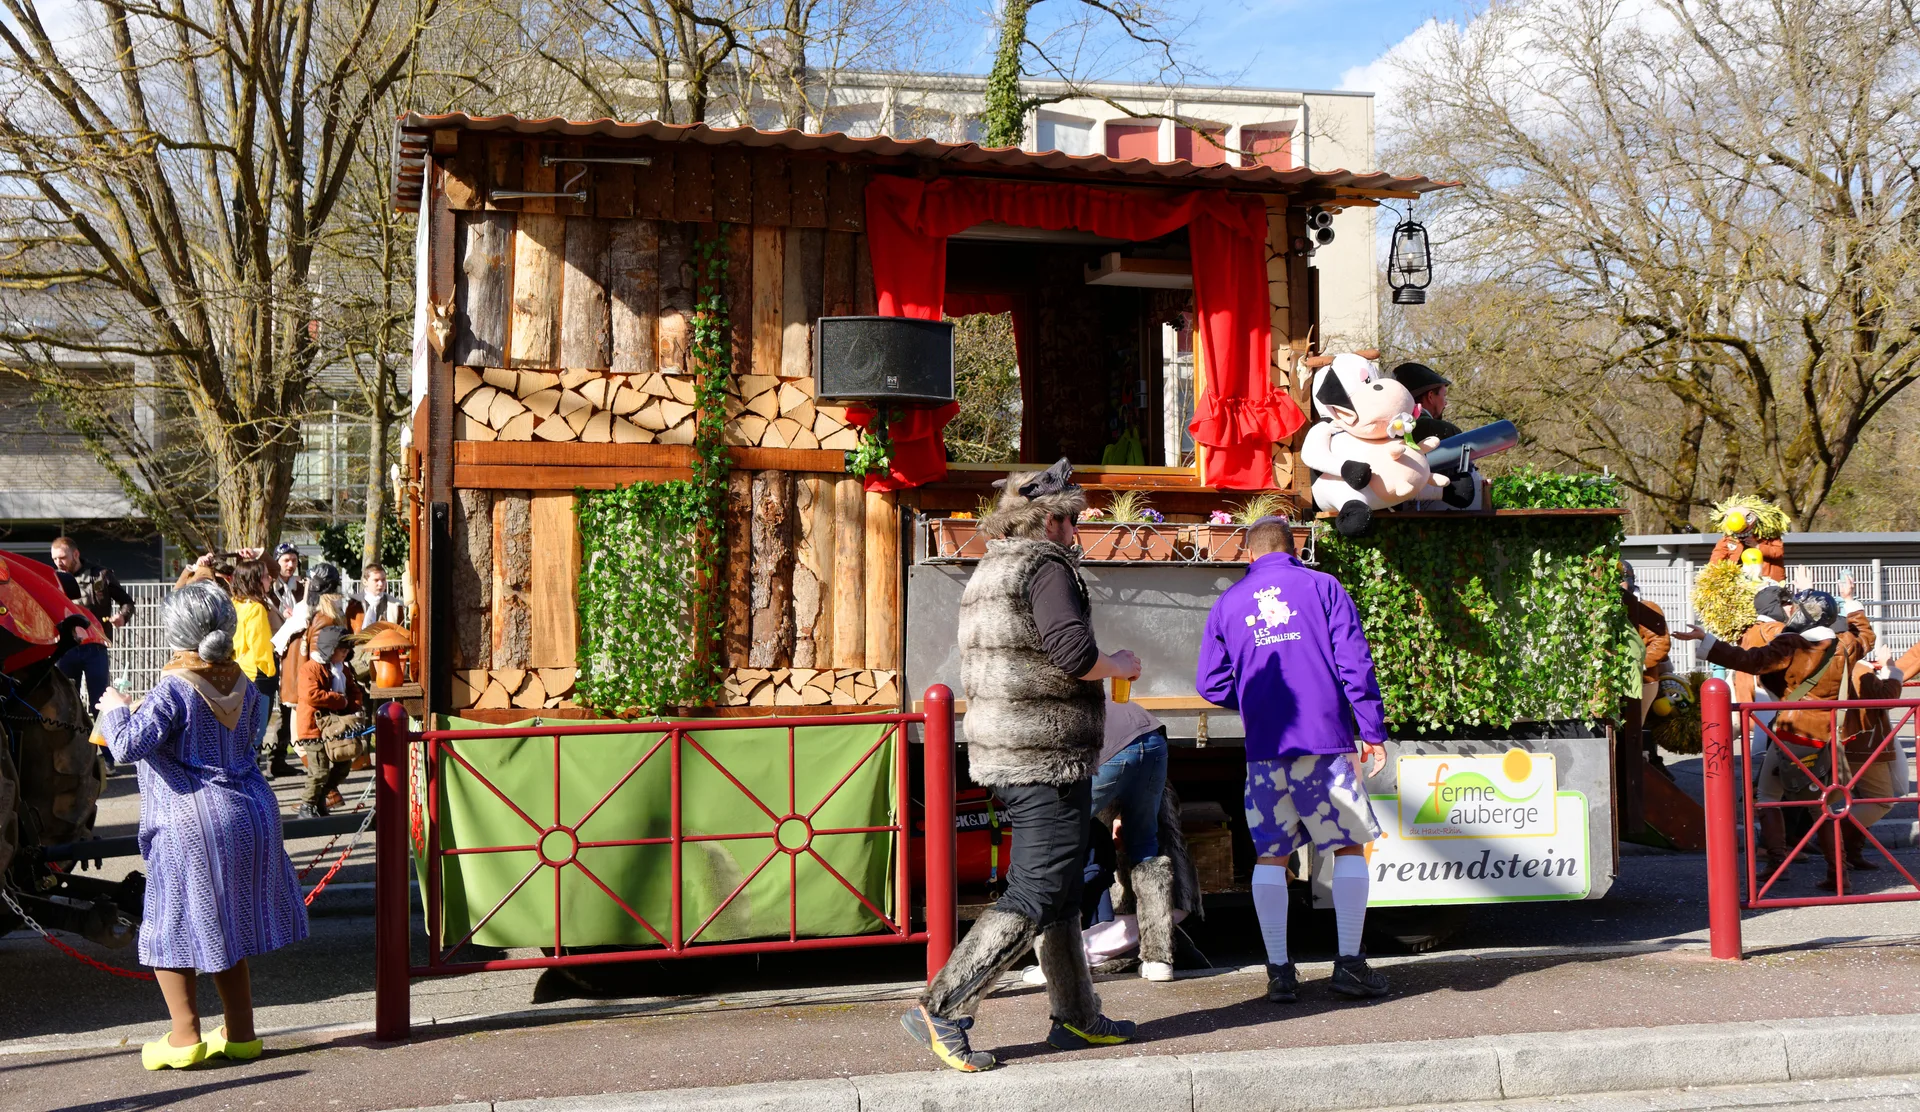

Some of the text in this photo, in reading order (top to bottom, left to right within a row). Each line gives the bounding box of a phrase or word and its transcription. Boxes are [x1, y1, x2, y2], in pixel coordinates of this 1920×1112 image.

[1253, 628, 1270, 638] LES
[1255, 632, 1301, 646] SCHTALLEURS
[1428, 763, 1495, 815] ferme
[1451, 805, 1538, 829] auberge
[1422, 827, 1462, 835] Haut-Rhin
